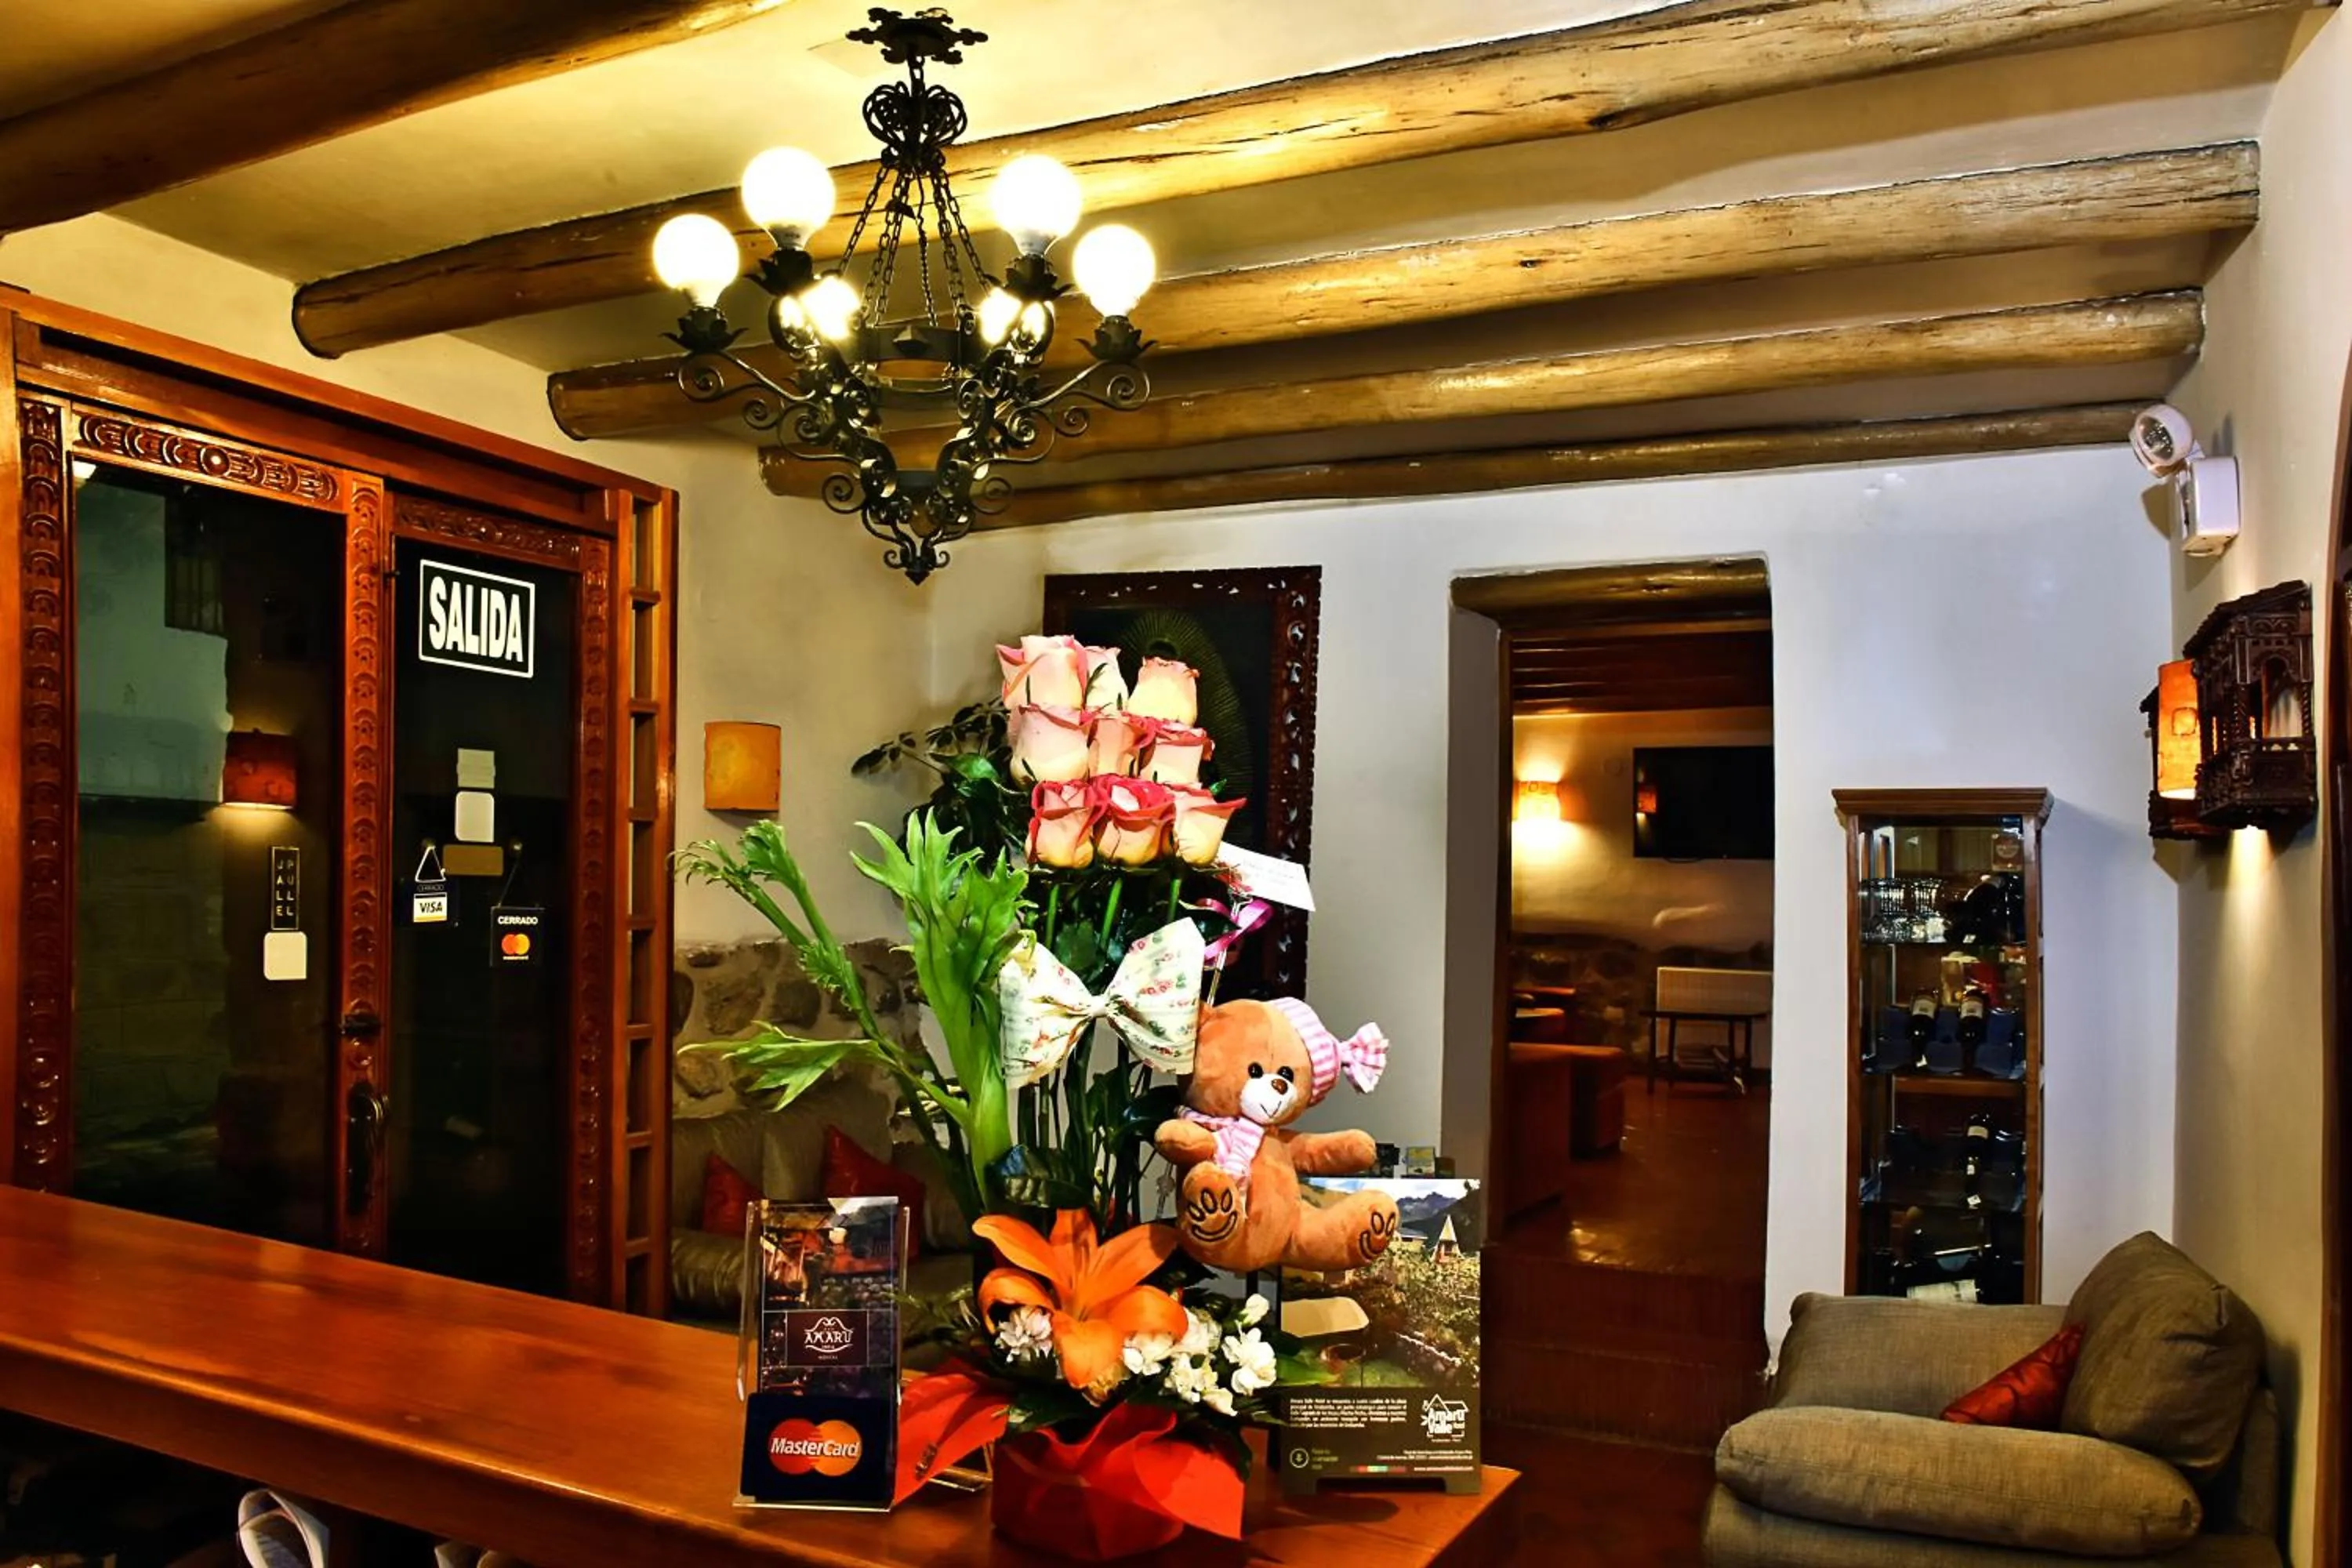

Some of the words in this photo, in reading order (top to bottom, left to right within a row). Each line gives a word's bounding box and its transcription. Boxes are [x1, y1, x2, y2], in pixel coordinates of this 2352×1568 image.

[428, 575, 524, 663] SALIDA
[276, 859, 285, 916] JALE
[287, 859, 296, 916] PULL
[419, 902, 443, 913] VISA
[497, 915, 539, 925] CERRADO
[804, 1330, 854, 1344] AMARU
[771, 1437, 861, 1457] MasterCard
